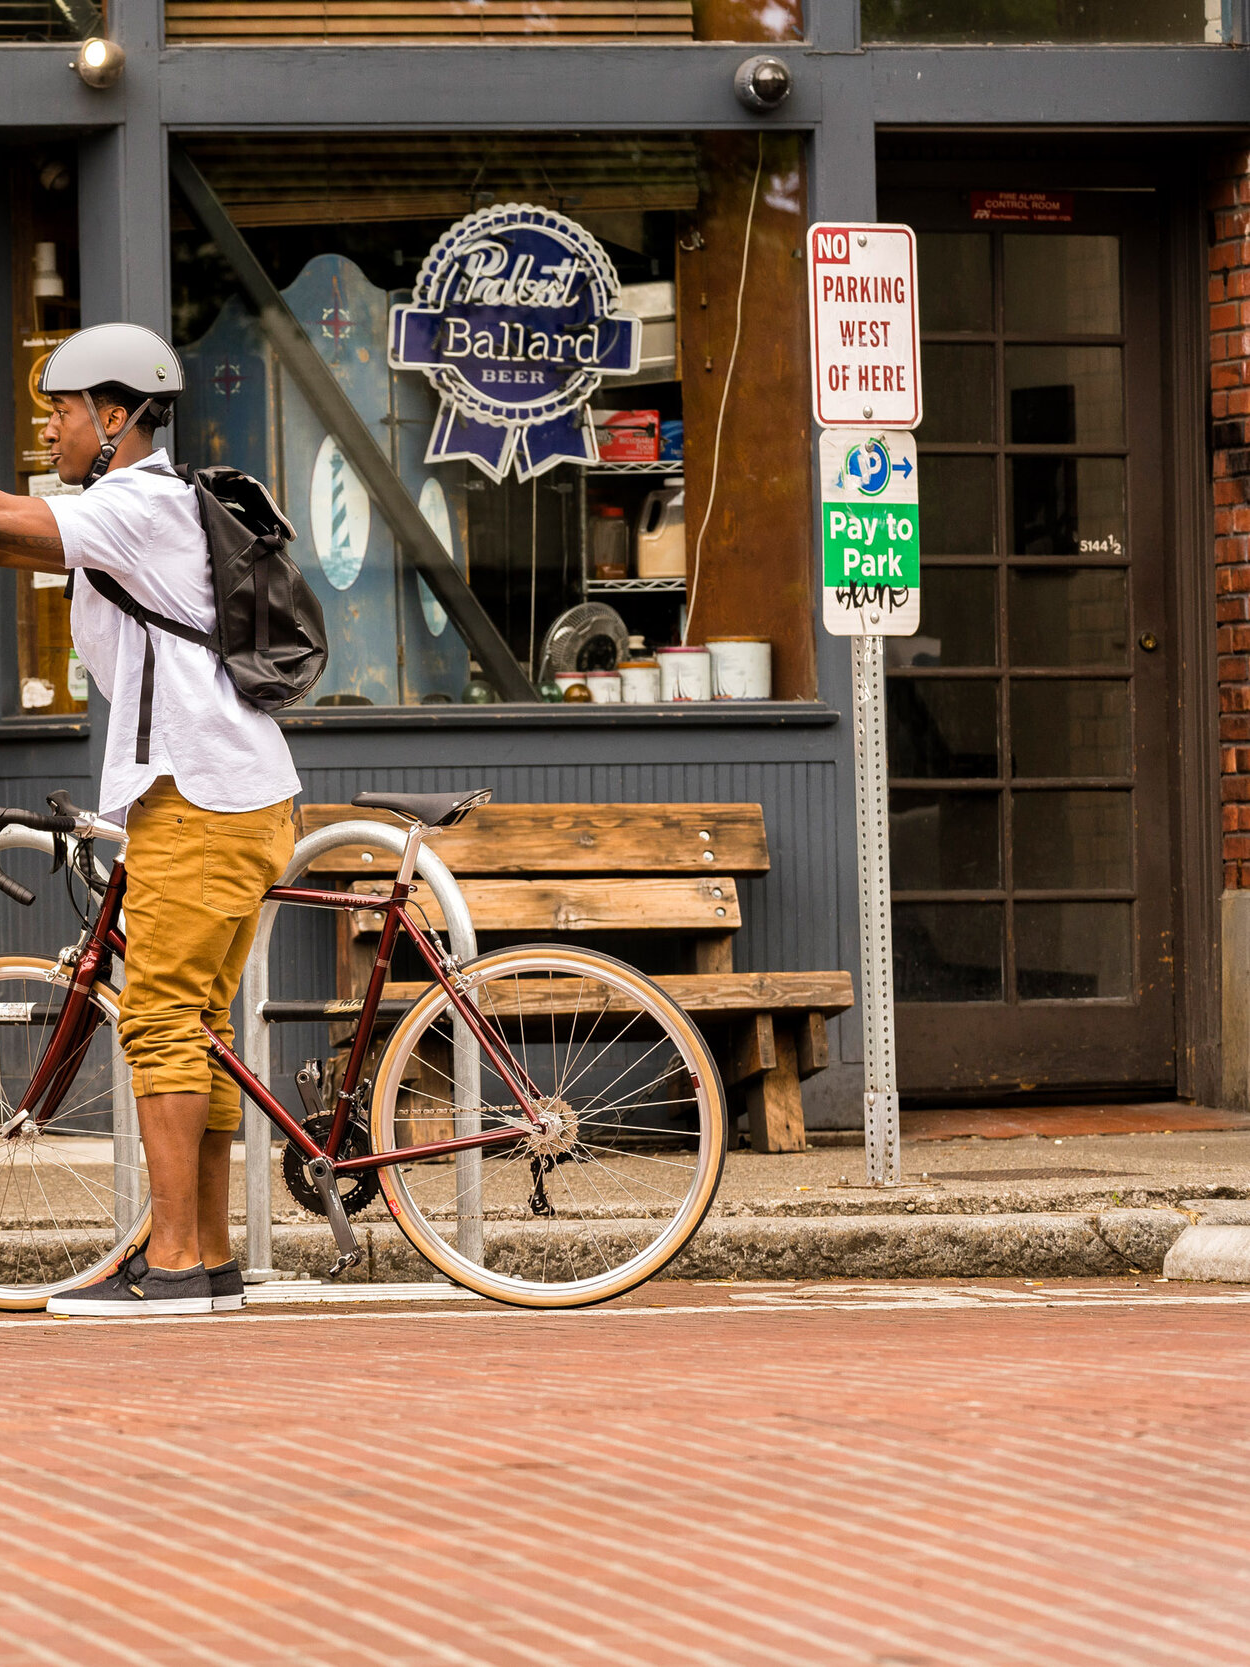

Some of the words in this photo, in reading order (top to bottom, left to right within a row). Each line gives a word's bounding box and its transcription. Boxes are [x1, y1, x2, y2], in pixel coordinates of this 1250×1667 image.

[985, 200, 1030, 209] CONTROL
[1031, 201, 1060, 210] ROOM
[999, 192, 1017, 200] FIRE
[817, 233, 847, 260] NO
[453, 240, 588, 307] Pabst
[823, 275, 905, 304] PARKING
[443, 317, 599, 364] Ballard
[839, 320, 891, 348] WEST
[481, 370, 545, 384] BEER
[828, 364, 851, 392] OF
[858, 365, 906, 392] HERE
[829, 511, 878, 546] Pay
[886, 512, 913, 541] to
[843, 547, 903, 577] Park
[349, 897, 370, 905] SPORT
